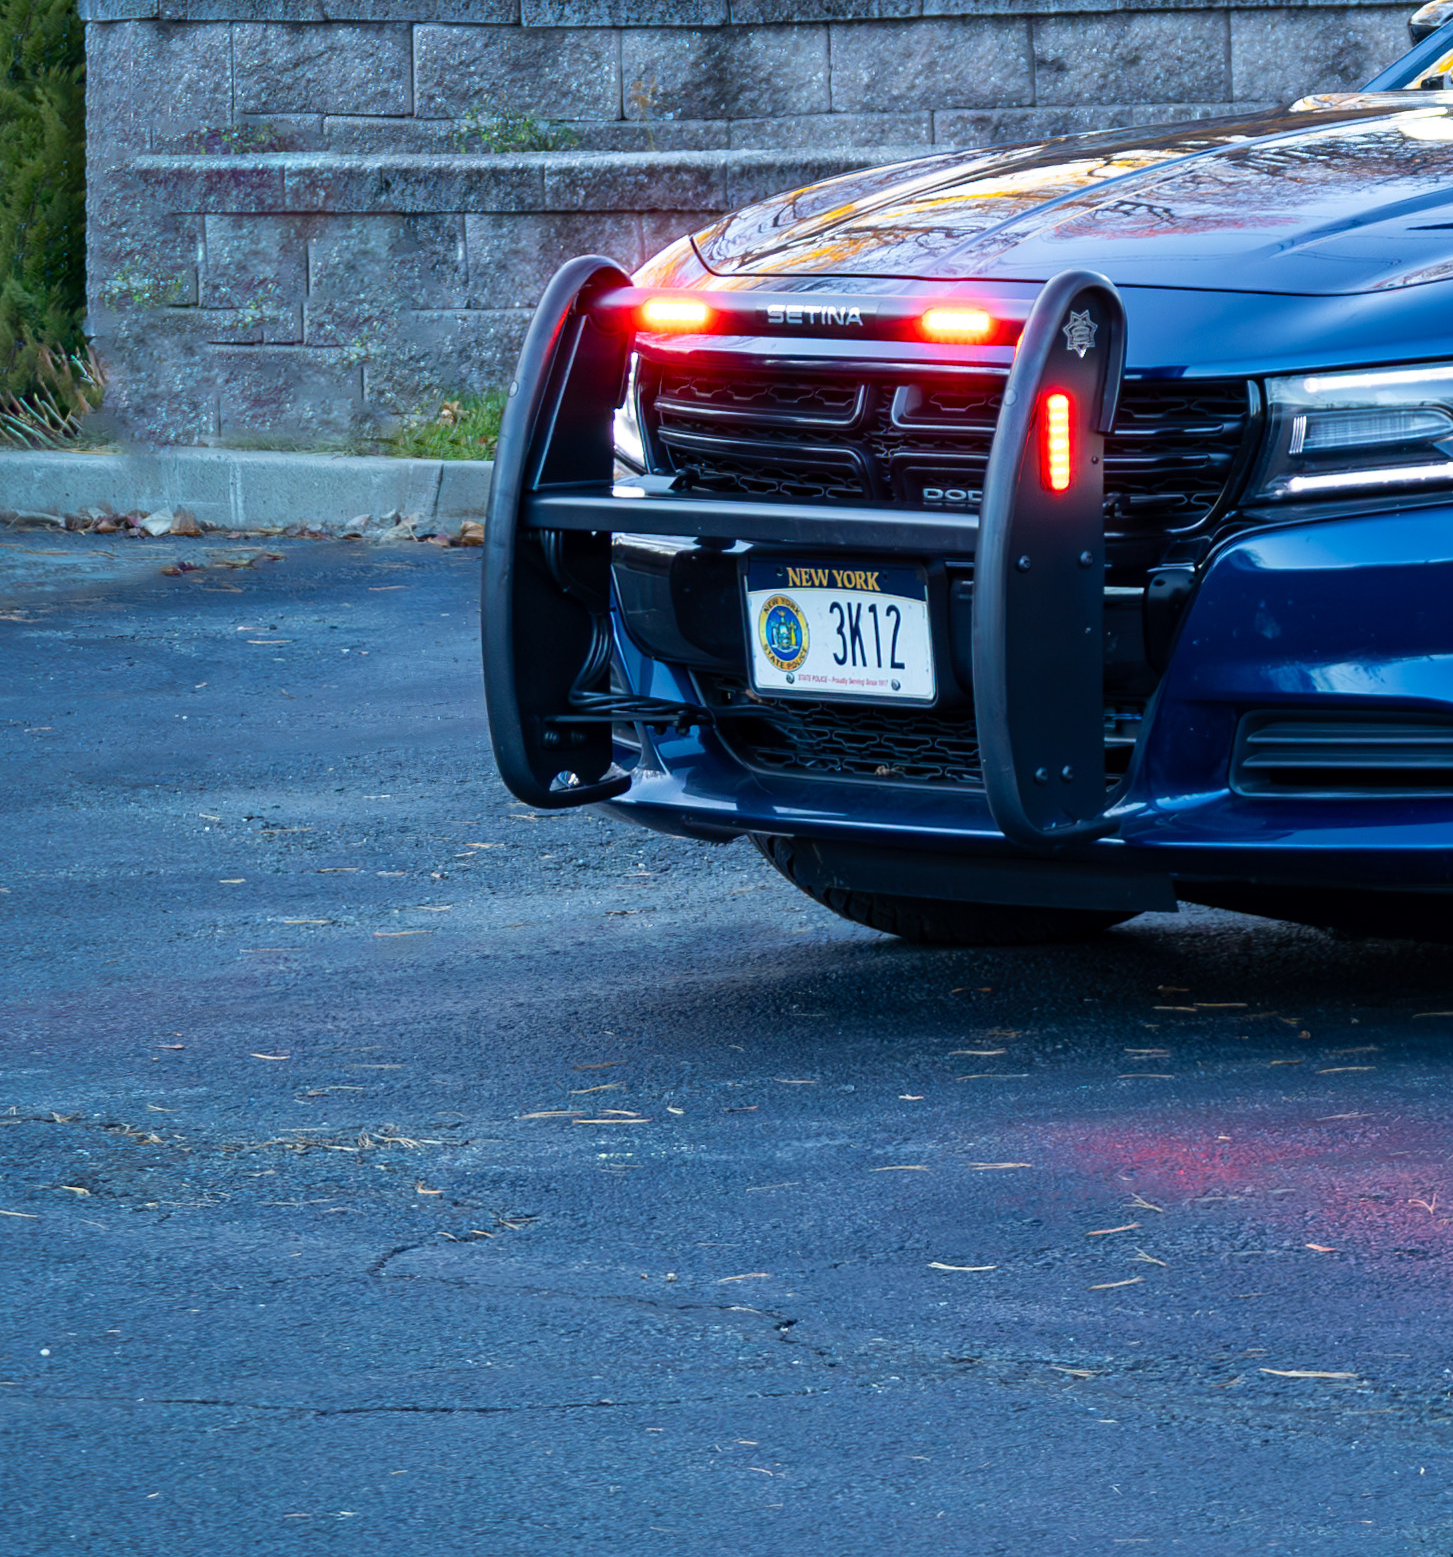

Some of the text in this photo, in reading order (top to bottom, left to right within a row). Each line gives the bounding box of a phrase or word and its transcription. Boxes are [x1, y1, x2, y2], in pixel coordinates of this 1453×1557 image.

[767, 304, 864, 326] SETINA
[923, 488, 984, 502] DOD
[787, 567, 881, 591] NEW YORK
[829, 601, 905, 670] 3K12
[798, 674, 811, 682] STATE
[812, 675, 828, 683] POLICE
